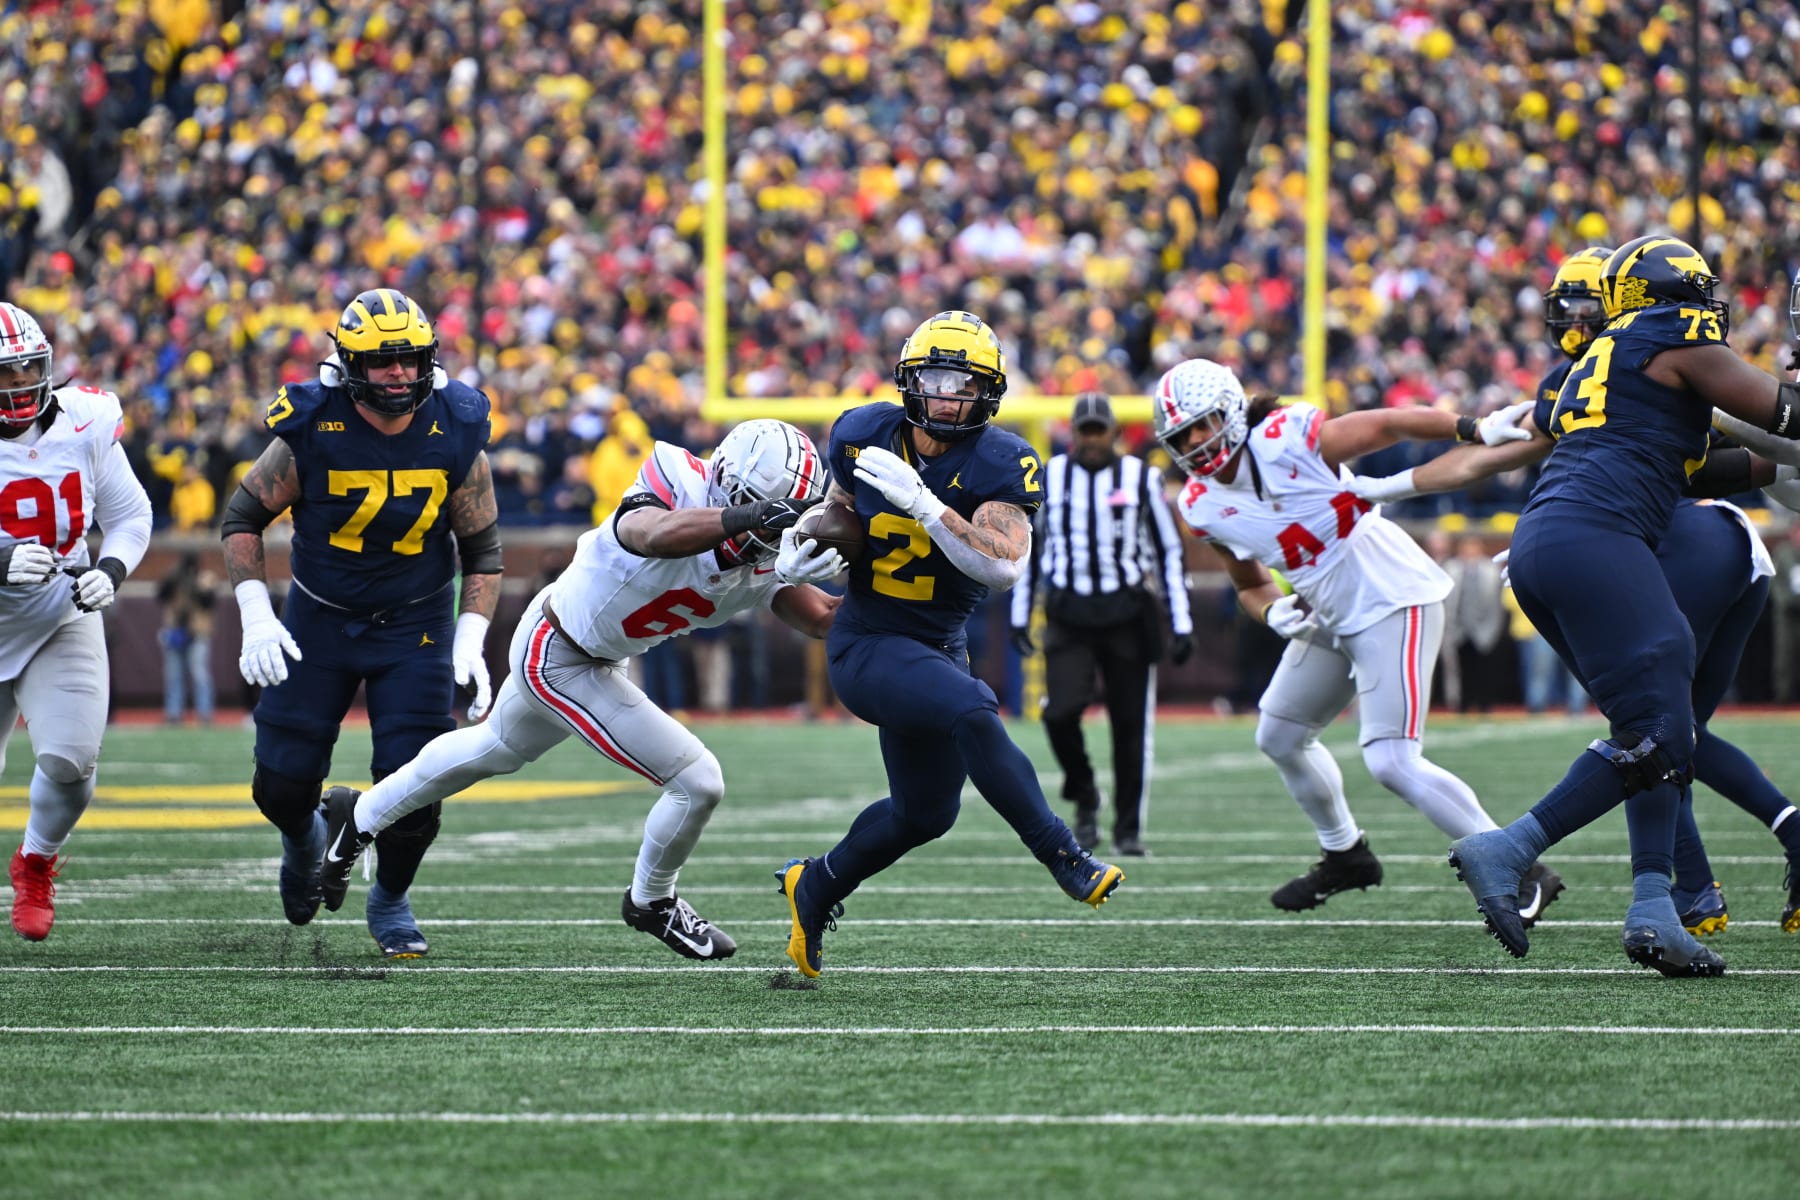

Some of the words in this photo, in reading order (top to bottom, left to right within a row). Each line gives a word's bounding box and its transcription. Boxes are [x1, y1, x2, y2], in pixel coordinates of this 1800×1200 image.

[1679, 307, 1722, 341] 73
[1549, 336, 1616, 441] 3
[0, 471, 85, 557] 91
[328, 468, 450, 556] 77
[1020, 455, 1041, 493] 2
[868, 511, 936, 601] 2
[621, 587, 717, 639] 6
